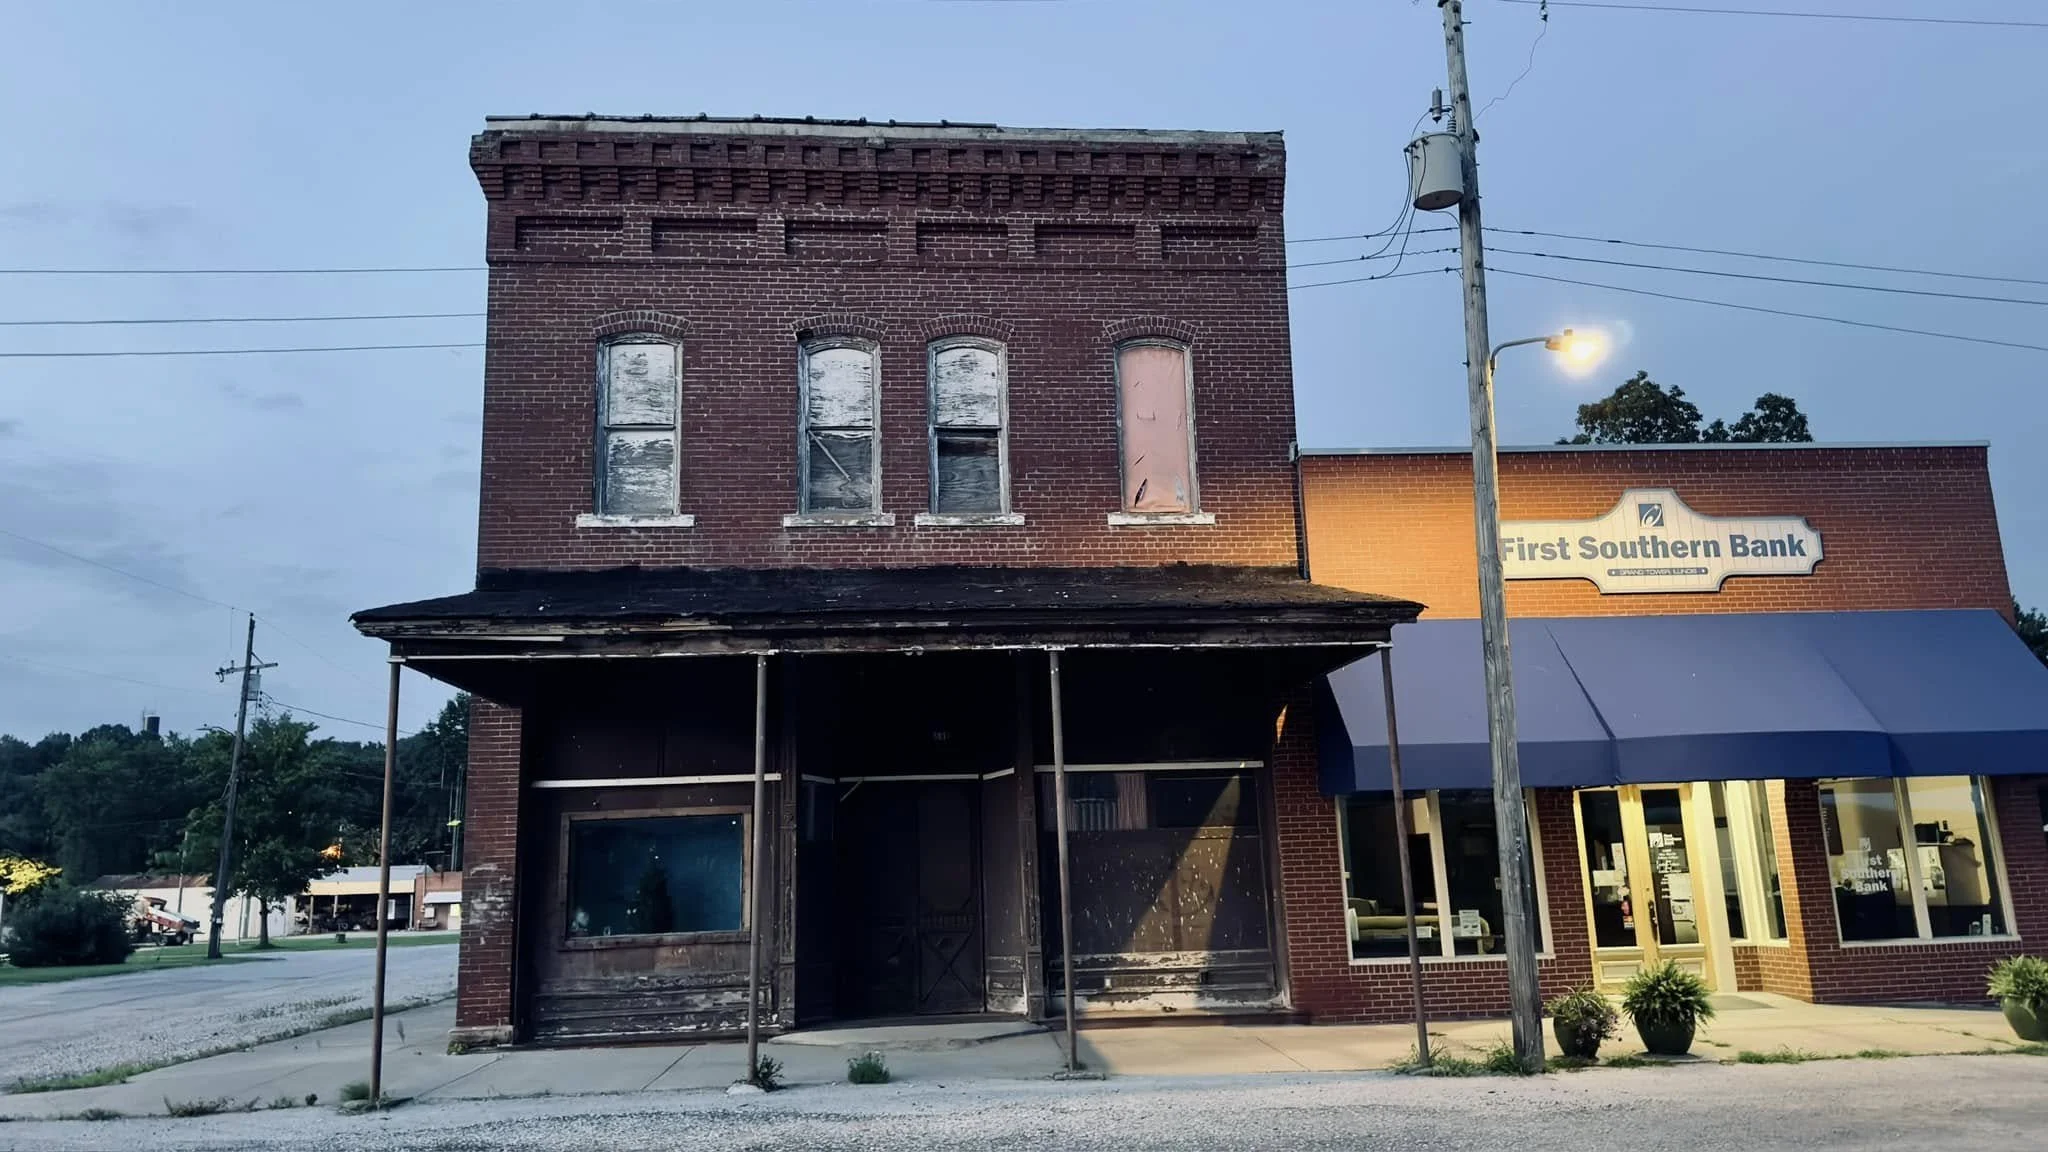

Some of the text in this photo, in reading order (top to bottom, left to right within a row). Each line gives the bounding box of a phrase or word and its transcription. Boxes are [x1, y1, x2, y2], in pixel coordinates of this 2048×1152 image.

[1500, 533, 1807, 561] First Southern Bank
[1855, 880, 1888, 893] Bank
